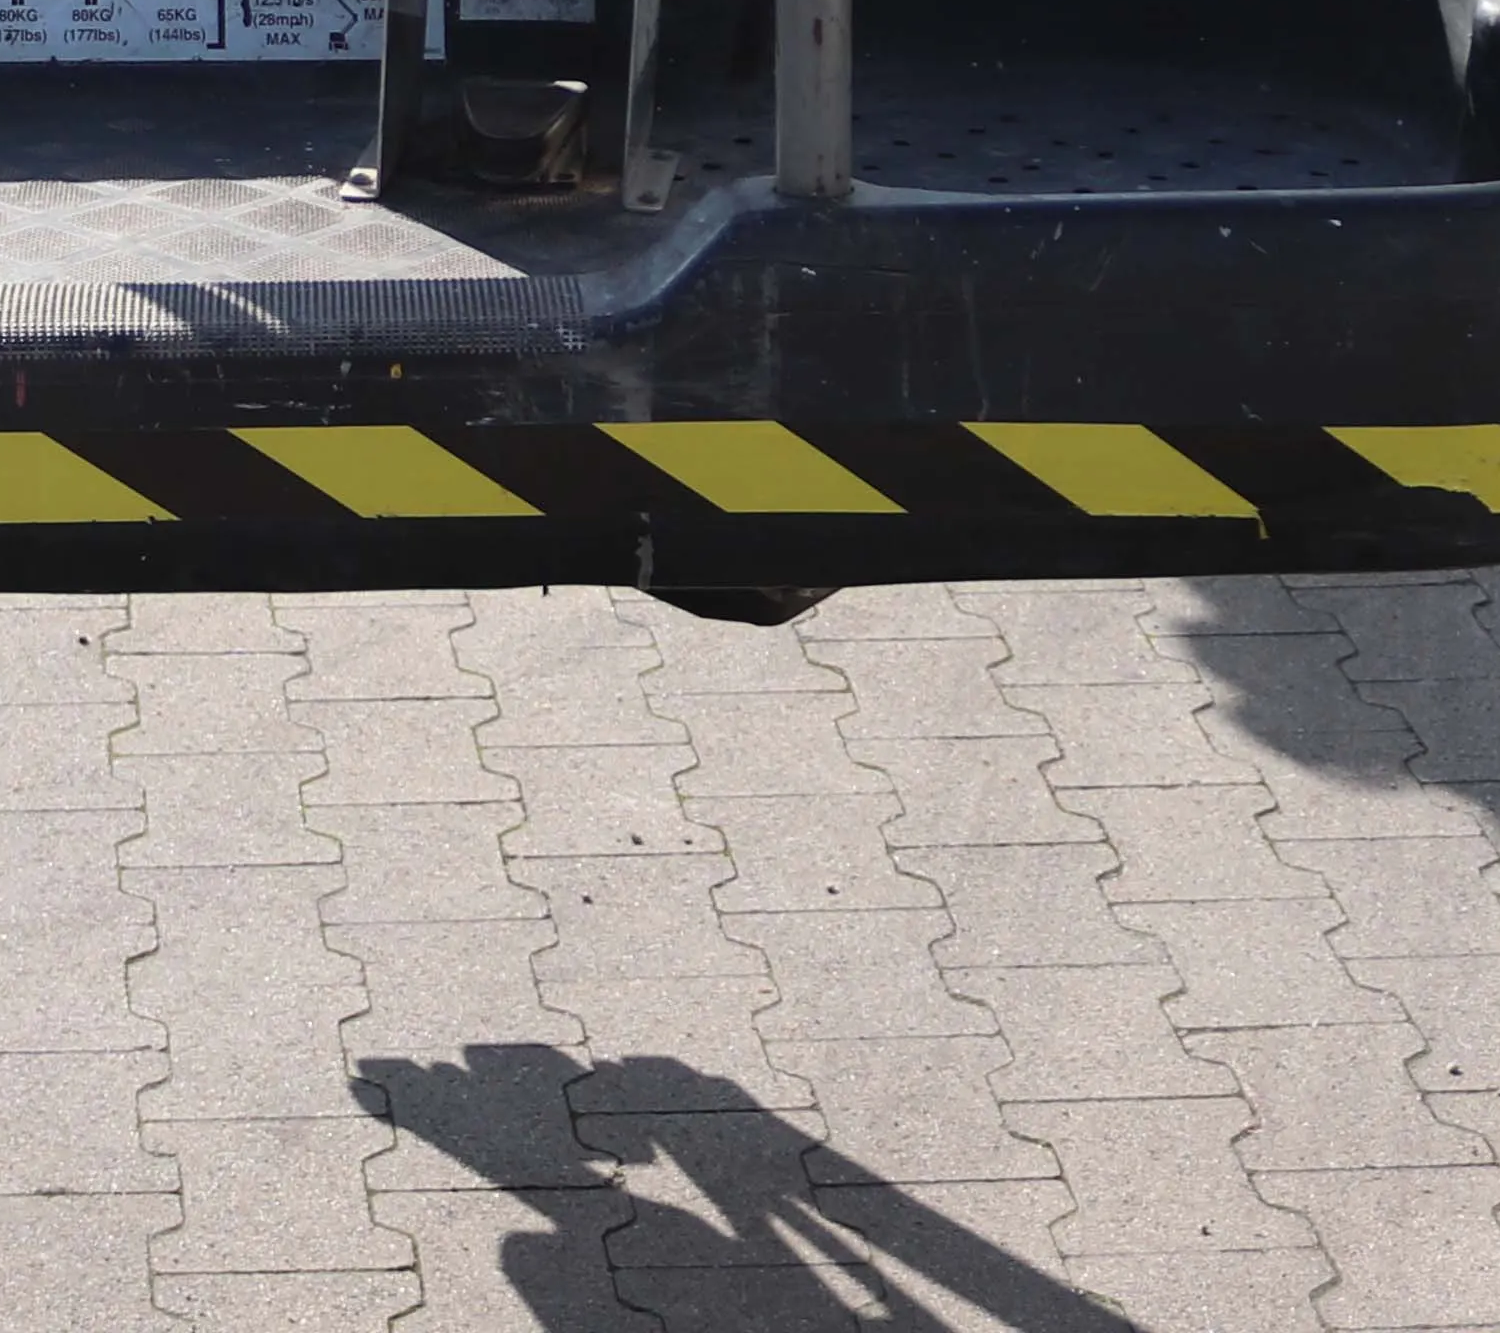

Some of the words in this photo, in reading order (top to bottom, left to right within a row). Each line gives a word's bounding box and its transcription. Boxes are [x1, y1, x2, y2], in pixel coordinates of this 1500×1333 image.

[72, 8, 112, 22] 80KG
[157, 7, 197, 21] 65KG
[64, 28, 120, 43] (177lbs)
[149, 27, 206, 42] (144lbs)
[266, 33, 301, 46] MAX
